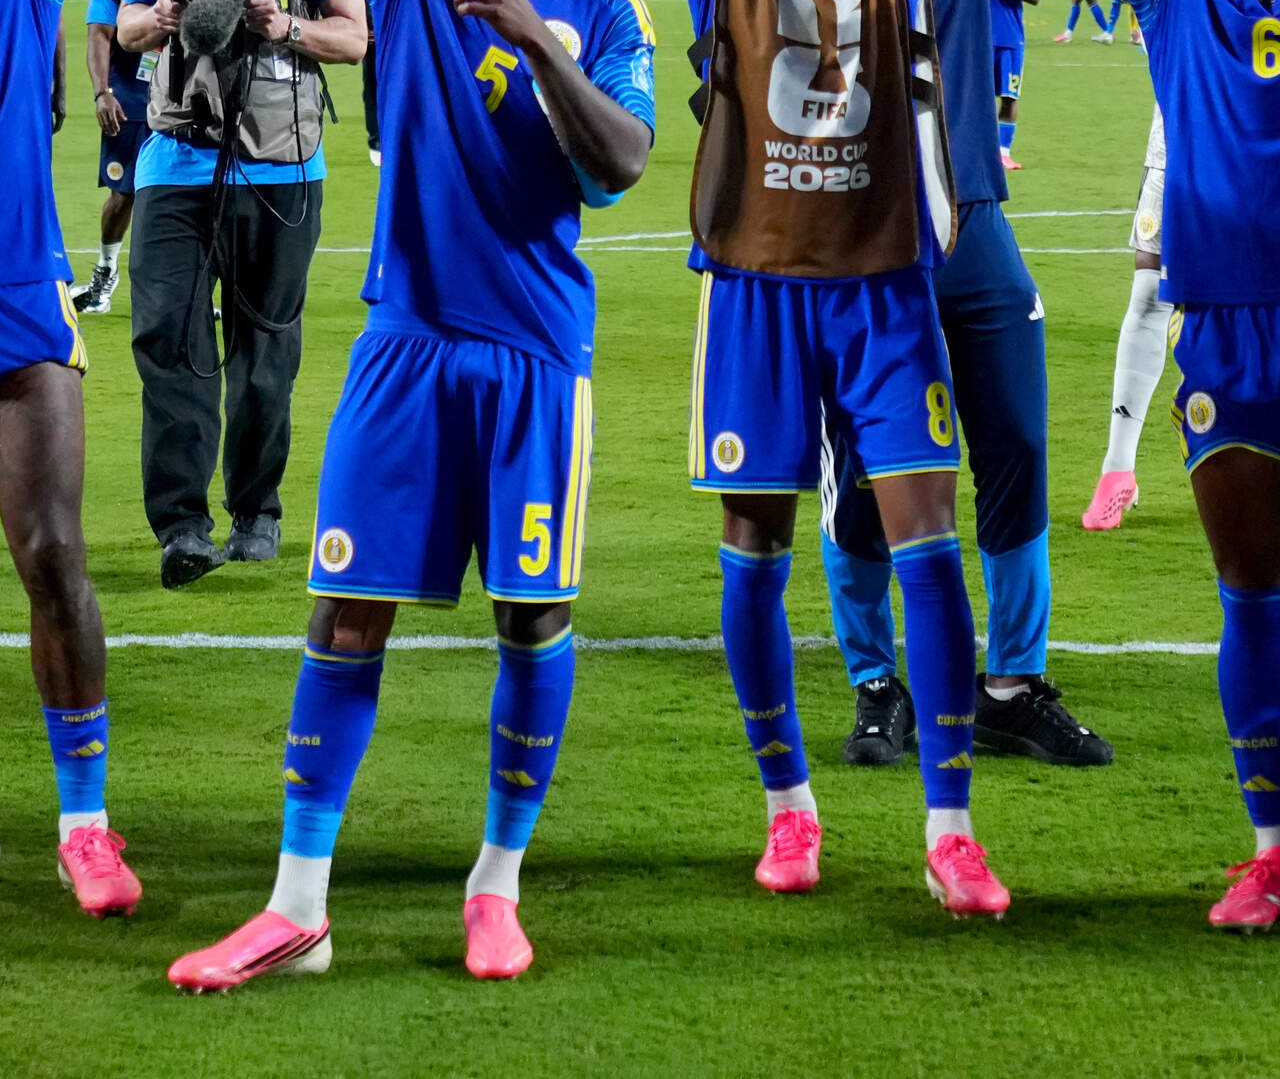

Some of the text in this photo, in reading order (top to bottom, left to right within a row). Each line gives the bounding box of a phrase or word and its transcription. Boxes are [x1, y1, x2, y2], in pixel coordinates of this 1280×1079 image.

[475, 45, 518, 113] 5
[801, 99, 847, 121] FIFA
[764, 140, 868, 162] WORLD CUP
[763, 161, 871, 192] 2026
[926, 381, 953, 448] 8
[518, 503, 551, 577] 5
